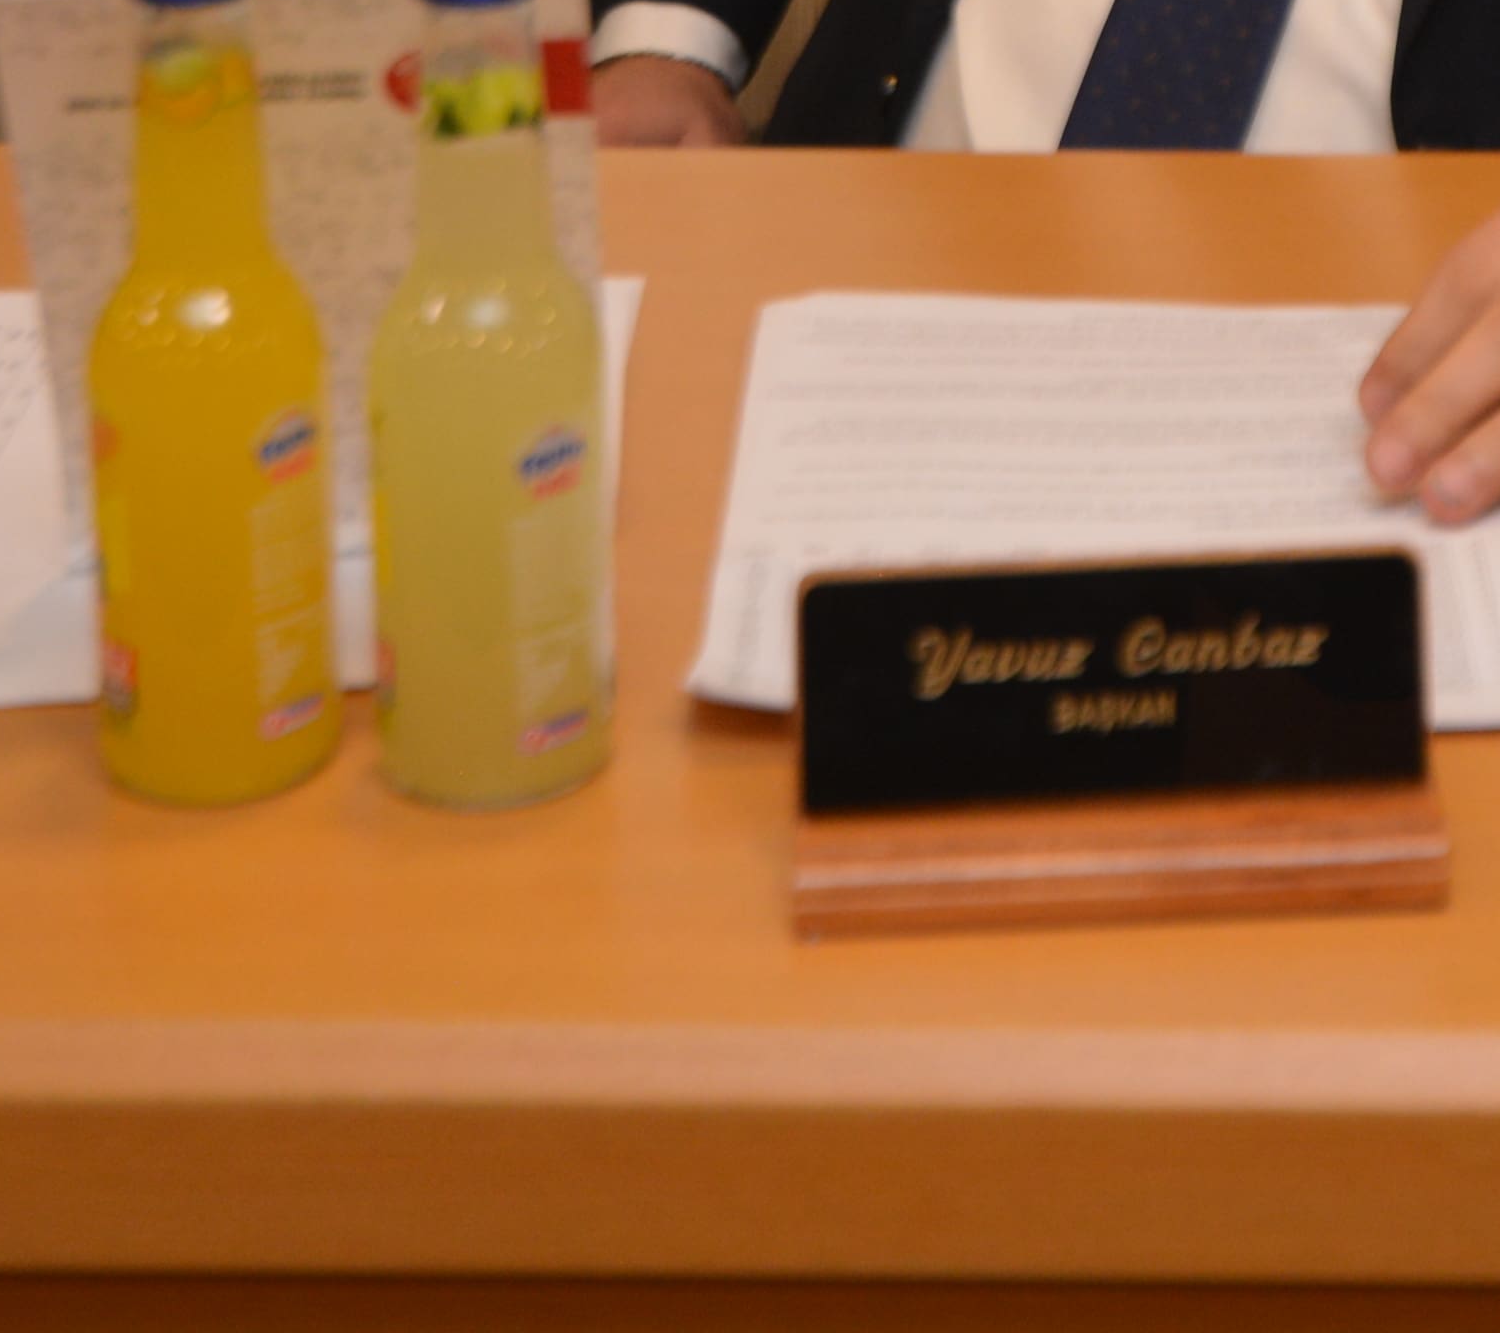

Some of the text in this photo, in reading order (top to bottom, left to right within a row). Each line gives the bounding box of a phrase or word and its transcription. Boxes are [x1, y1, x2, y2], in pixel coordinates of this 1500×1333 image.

[910, 611, 1329, 701] Yavuz Canbaz
[1050, 690, 1178, 735] BAŞKAN
